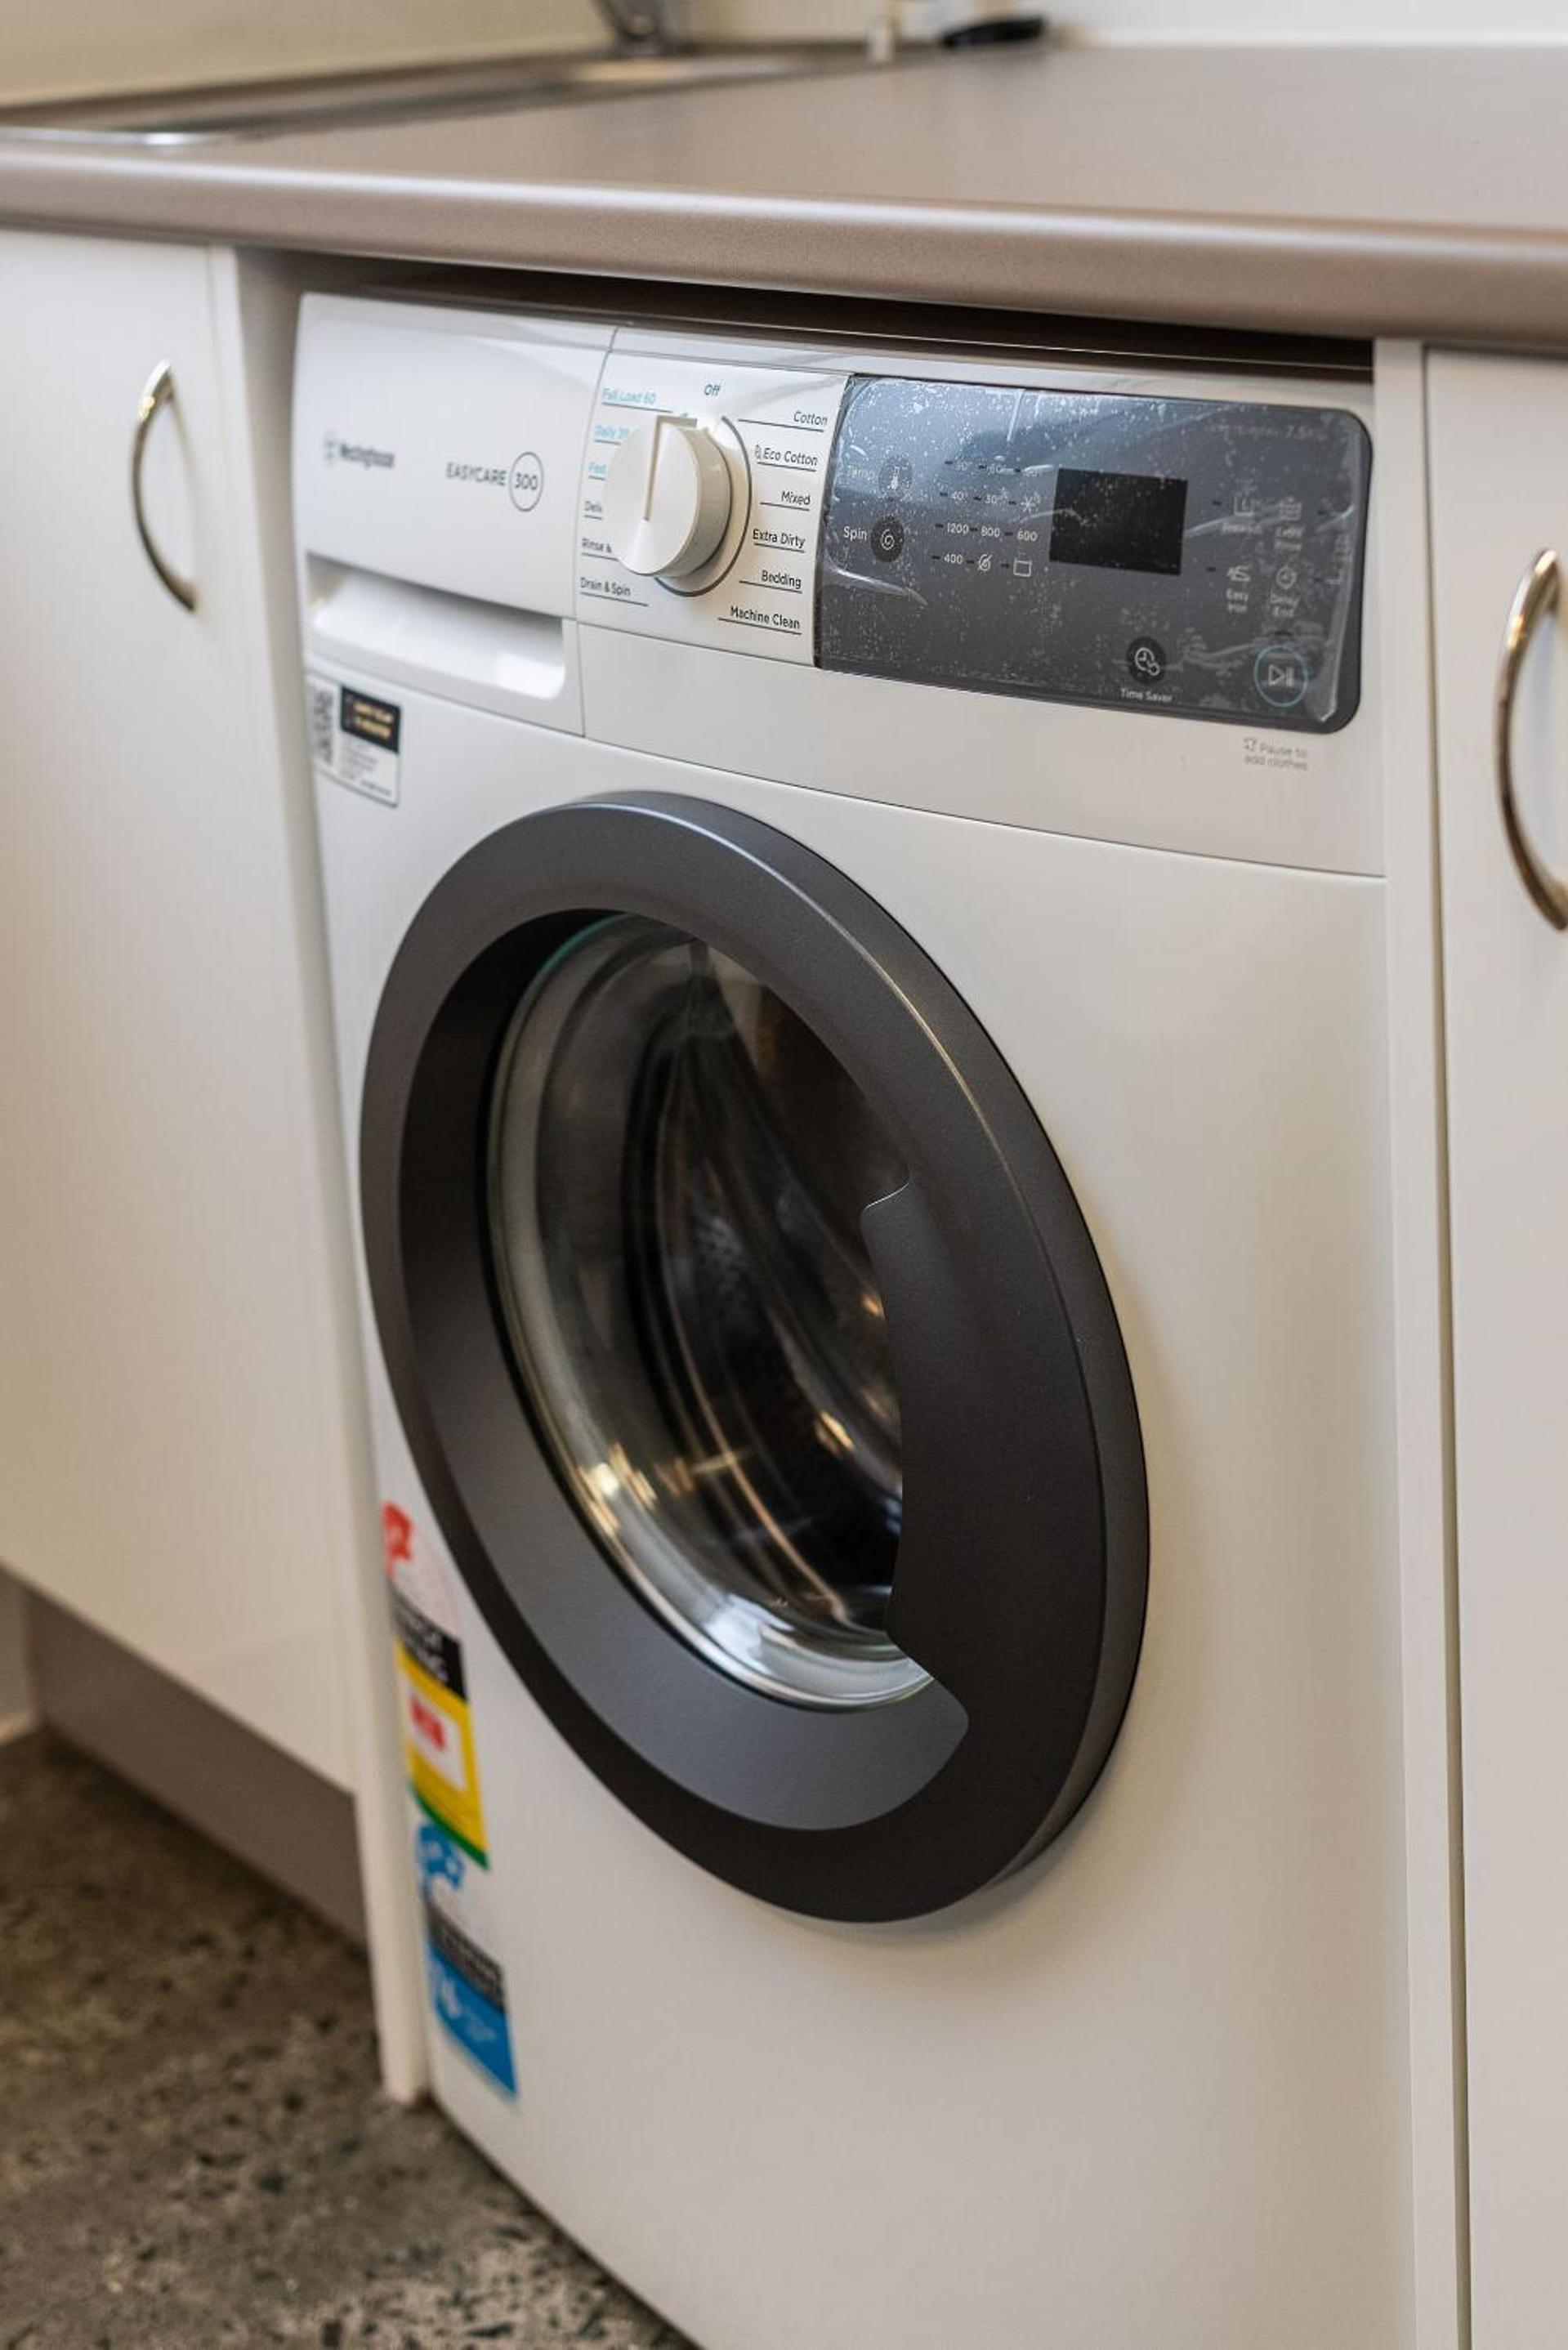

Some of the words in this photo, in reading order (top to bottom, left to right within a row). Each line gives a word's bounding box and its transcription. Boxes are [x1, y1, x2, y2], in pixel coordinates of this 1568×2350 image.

[704, 384, 721, 396] Off
[793, 411, 828, 426] Cotton
[763, 447, 781, 461] Eco
[784, 450, 818, 466] Cotton
[446, 462, 507, 487] EASYCARE
[514, 472, 539, 491] 300
[781, 490, 811, 506] Mixed
[753, 529, 779, 543] Extra
[781, 532, 806, 548] Dirty
[843, 525, 868, 543] Spin
[947, 523, 970, 535] 1200
[1017, 529, 1039, 542] 600
[581, 538, 604, 552] Rinse
[944, 554, 963, 565] 400
[579, 576, 603, 590] Drain
[611, 581, 632, 596] Spin
[762, 570, 802, 589] Bedding
[730, 605, 771, 625] Machine
[772, 614, 801, 630] Clean
